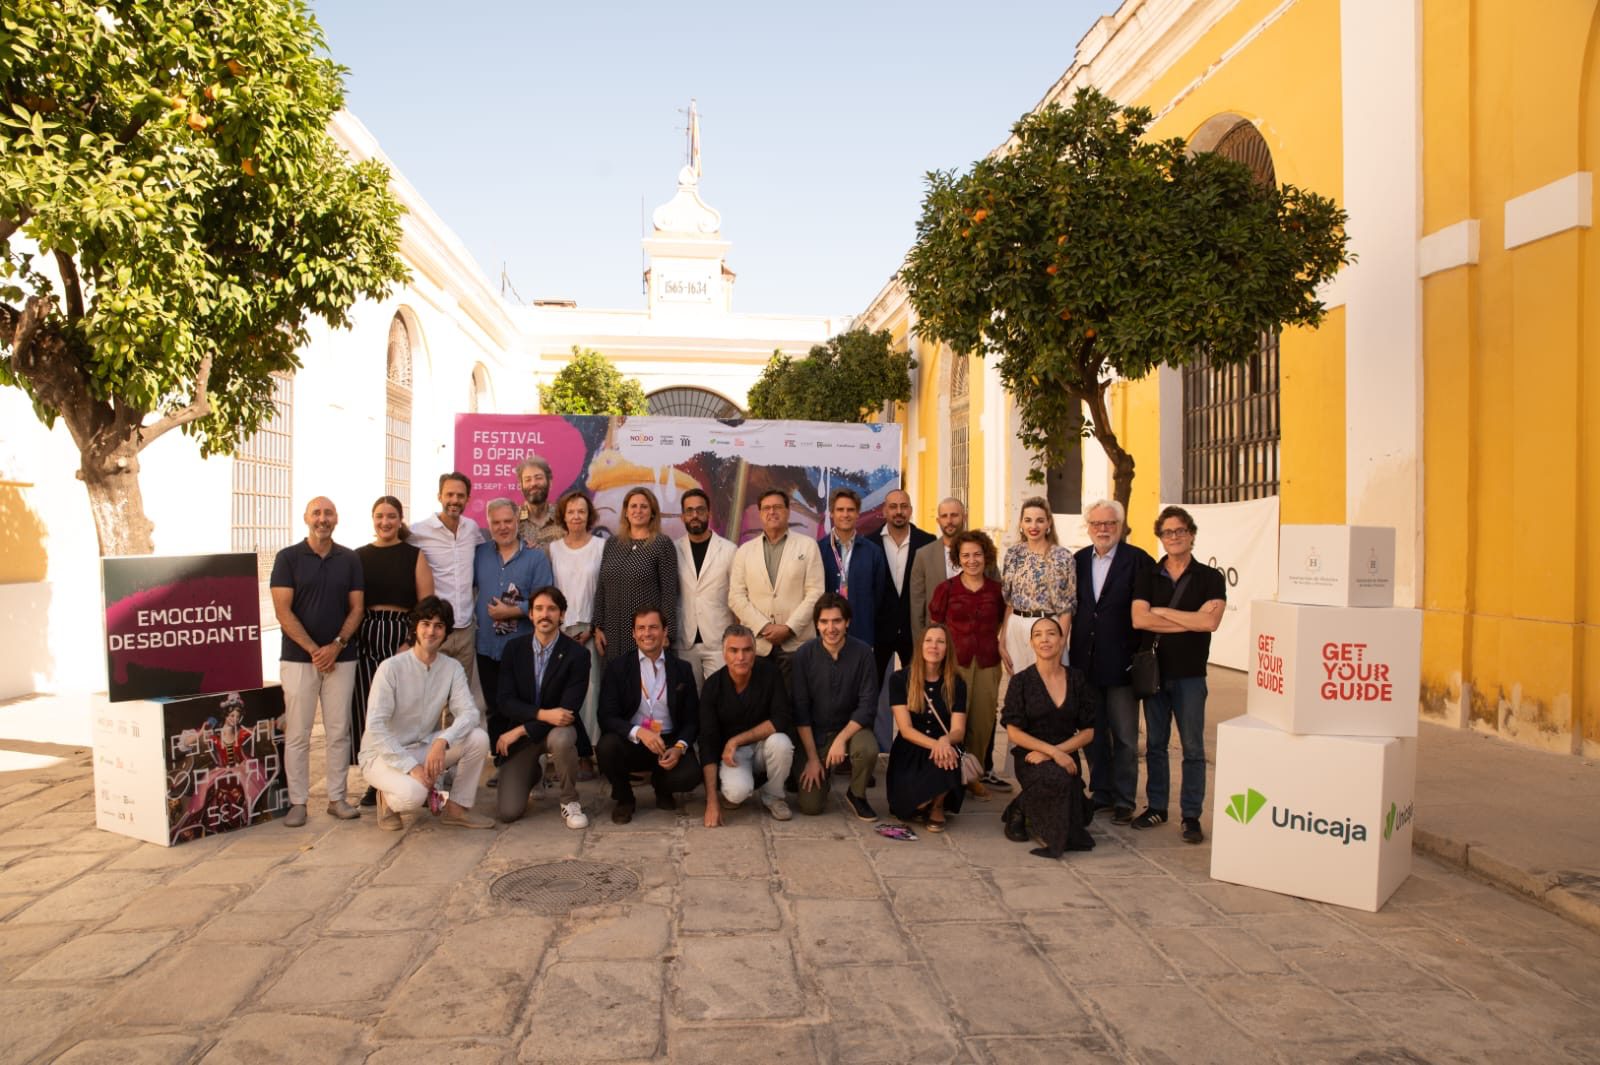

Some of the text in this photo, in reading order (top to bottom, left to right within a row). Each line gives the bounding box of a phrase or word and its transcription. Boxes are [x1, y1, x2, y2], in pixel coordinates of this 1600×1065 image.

[473, 431, 544, 444] FESTIVAL
[137, 600, 232, 626] EMOCIÓN
[109, 625, 259, 651] DESBORDANTE
[1258, 634, 1275, 653] GET
[1322, 643, 1367, 661] GET
[1258, 652, 1283, 675] YOUR
[1323, 662, 1390, 681] YOUR
[1256, 670, 1284, 695] GUIDE
[1320, 681, 1393, 702] GUIDE
[1272, 806, 1367, 845] Unicaja
